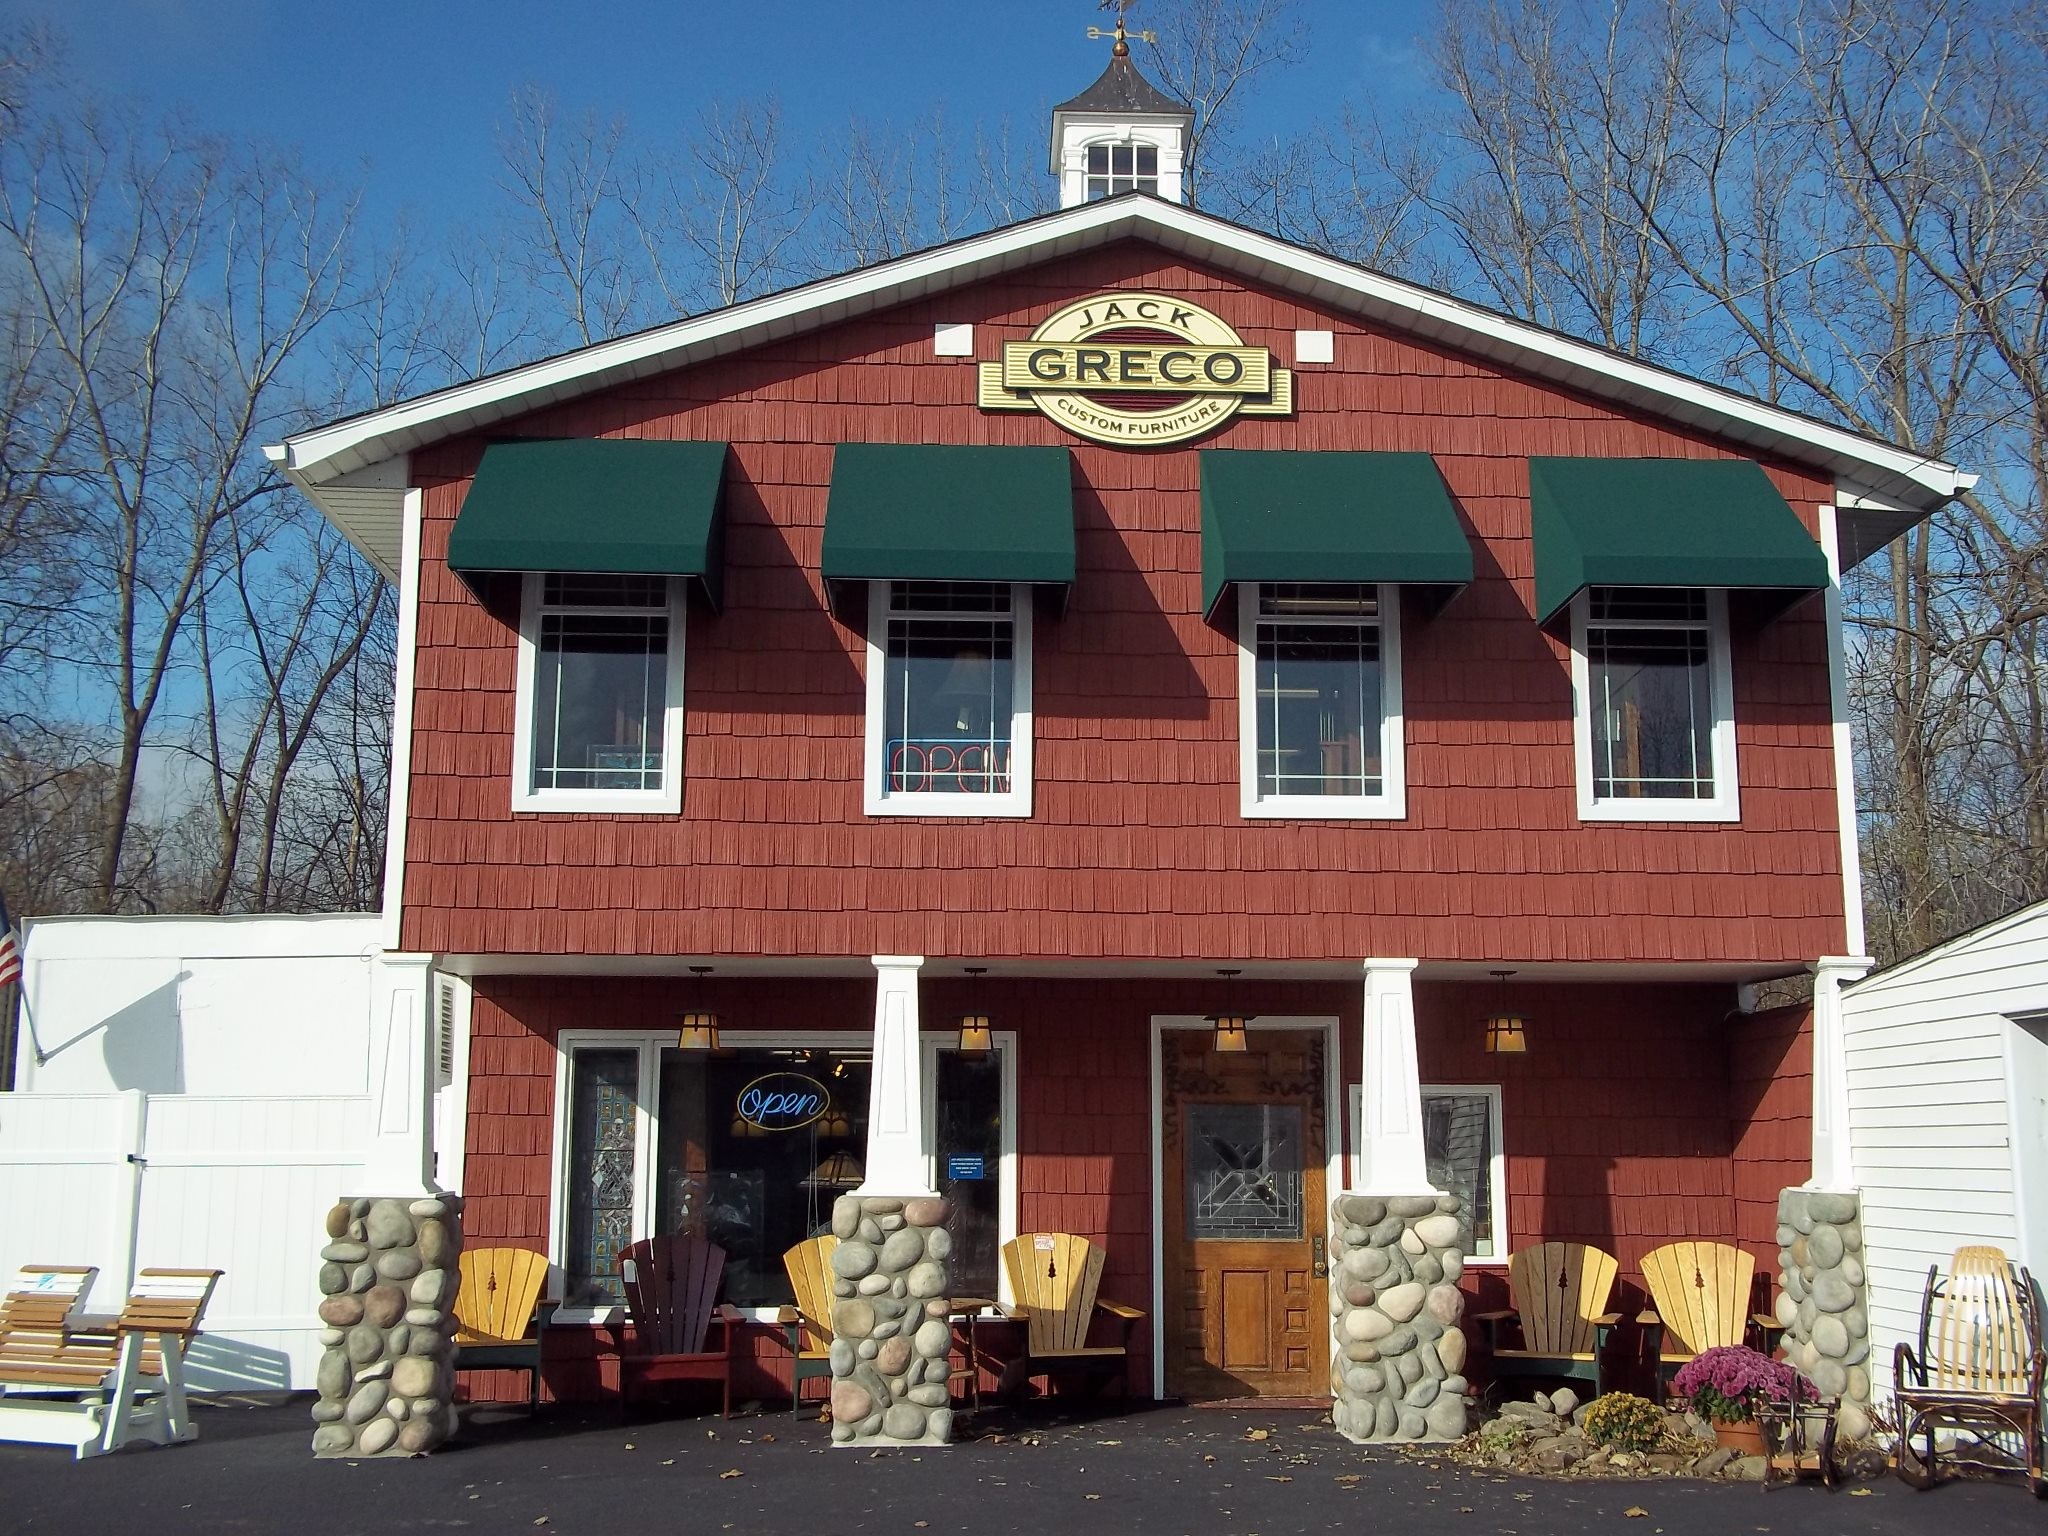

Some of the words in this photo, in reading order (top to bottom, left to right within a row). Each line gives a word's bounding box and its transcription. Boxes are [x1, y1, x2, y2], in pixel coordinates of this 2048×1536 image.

[1079, 301, 1195, 330] JACK
[1028, 348, 1243, 385] GRECO
[1056, 398, 1123, 434] CUSTOM
[1128, 401, 1221, 435] FURNITURE
[892, 745, 1010, 793] OPEN
